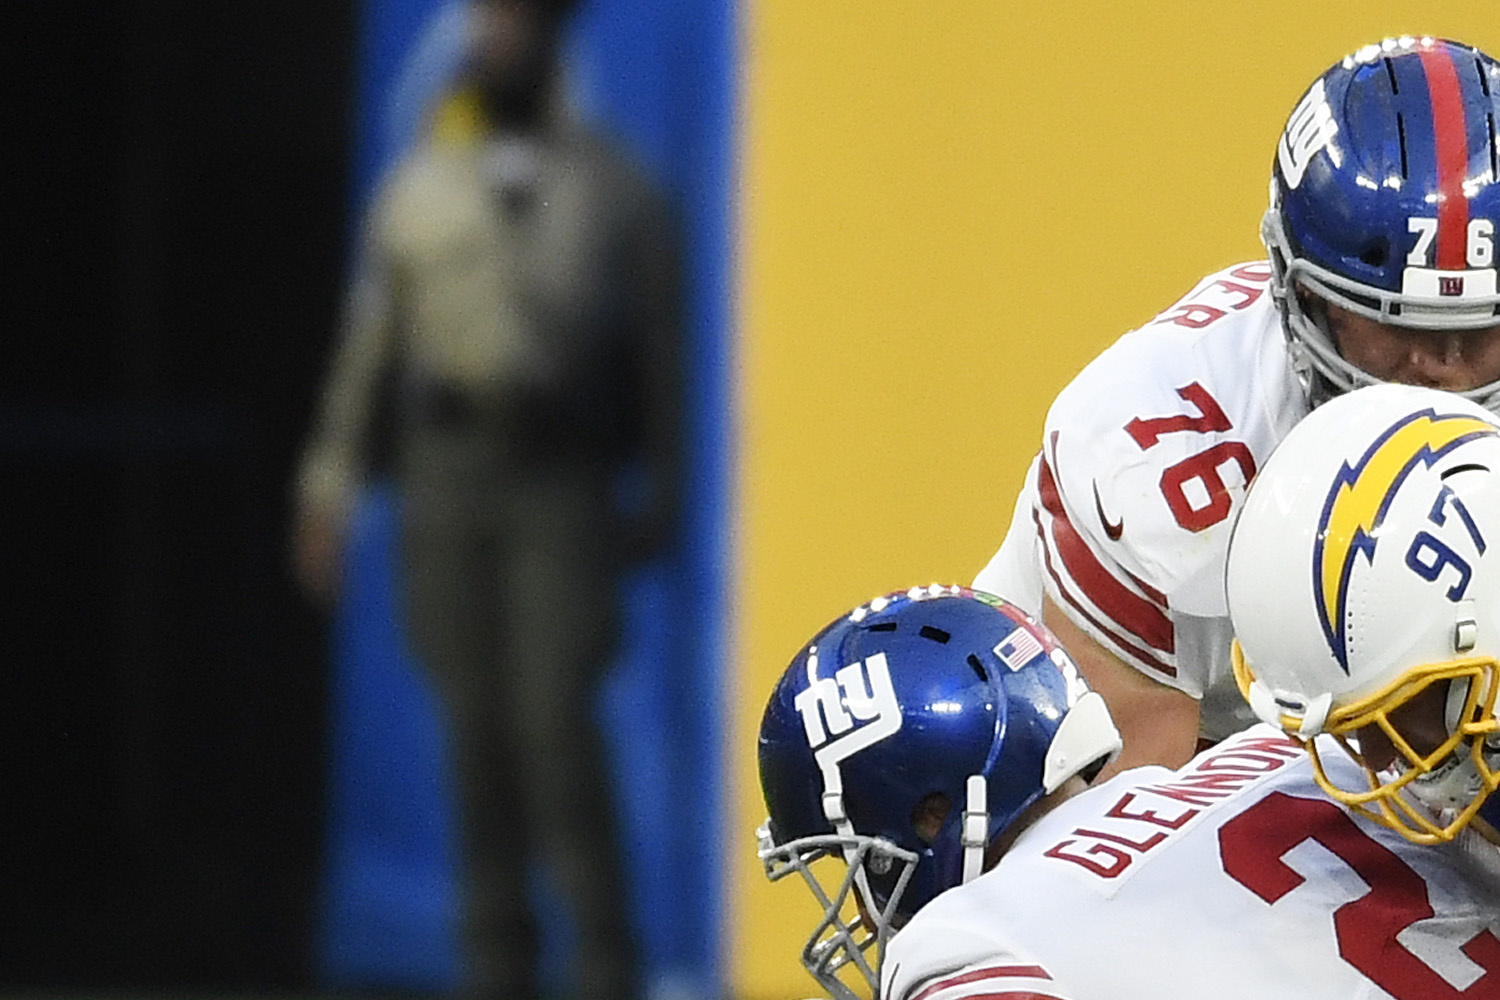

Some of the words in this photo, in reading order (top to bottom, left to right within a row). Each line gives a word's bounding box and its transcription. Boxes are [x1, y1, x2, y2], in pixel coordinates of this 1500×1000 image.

[1407, 217, 1494, 267] 76
[1123, 381, 1257, 533] 76
[1404, 484, 1487, 602] 97
[1044, 737, 1301, 879] GLENNON
